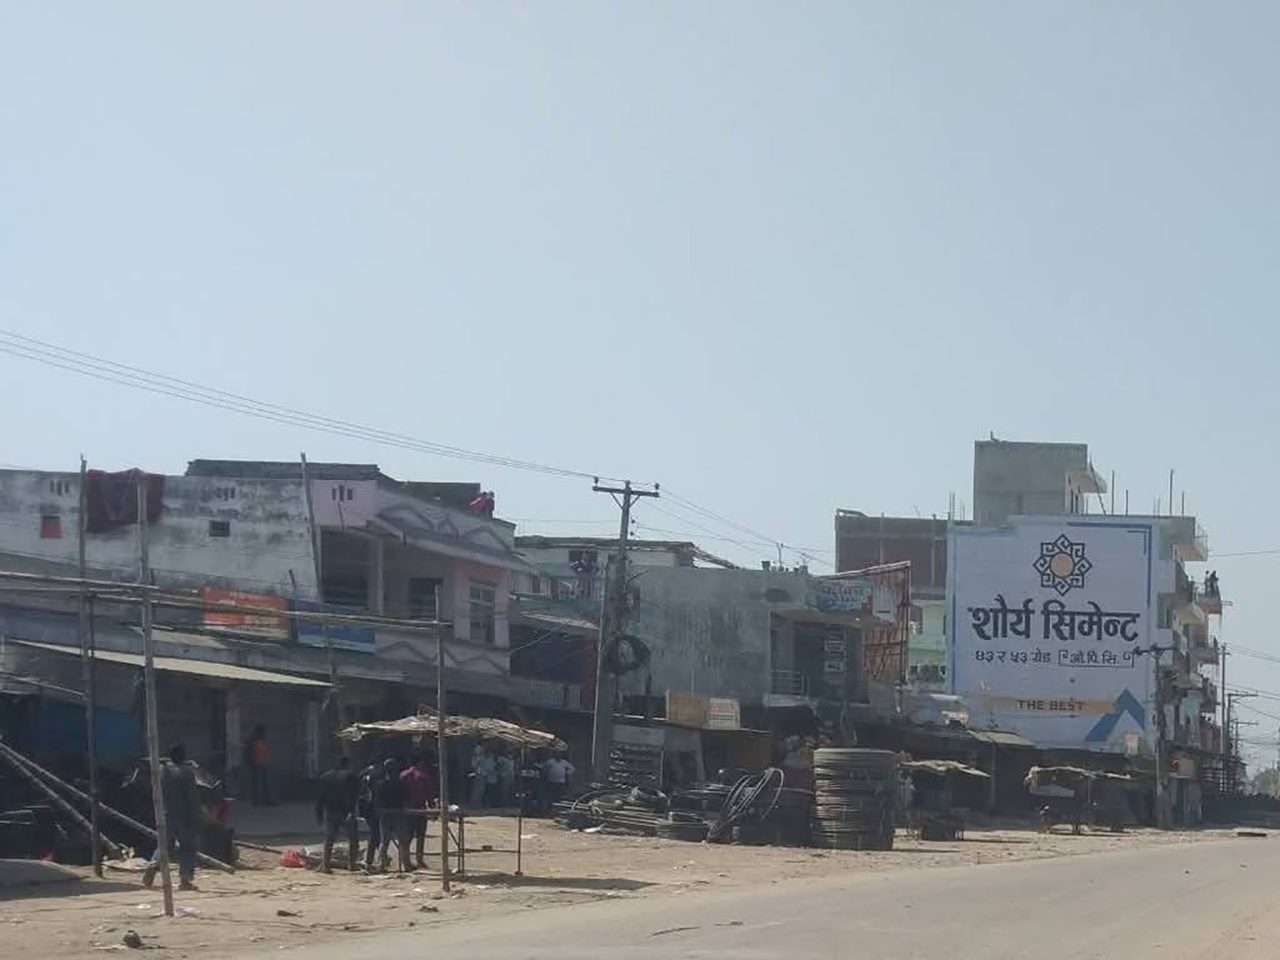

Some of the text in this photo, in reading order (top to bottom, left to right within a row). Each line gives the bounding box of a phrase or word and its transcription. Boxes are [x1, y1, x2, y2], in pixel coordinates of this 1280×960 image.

[967, 594, 1140, 641] शौर्य सिमेन्ट
[1017, 700, 1085, 712] THE BEST
